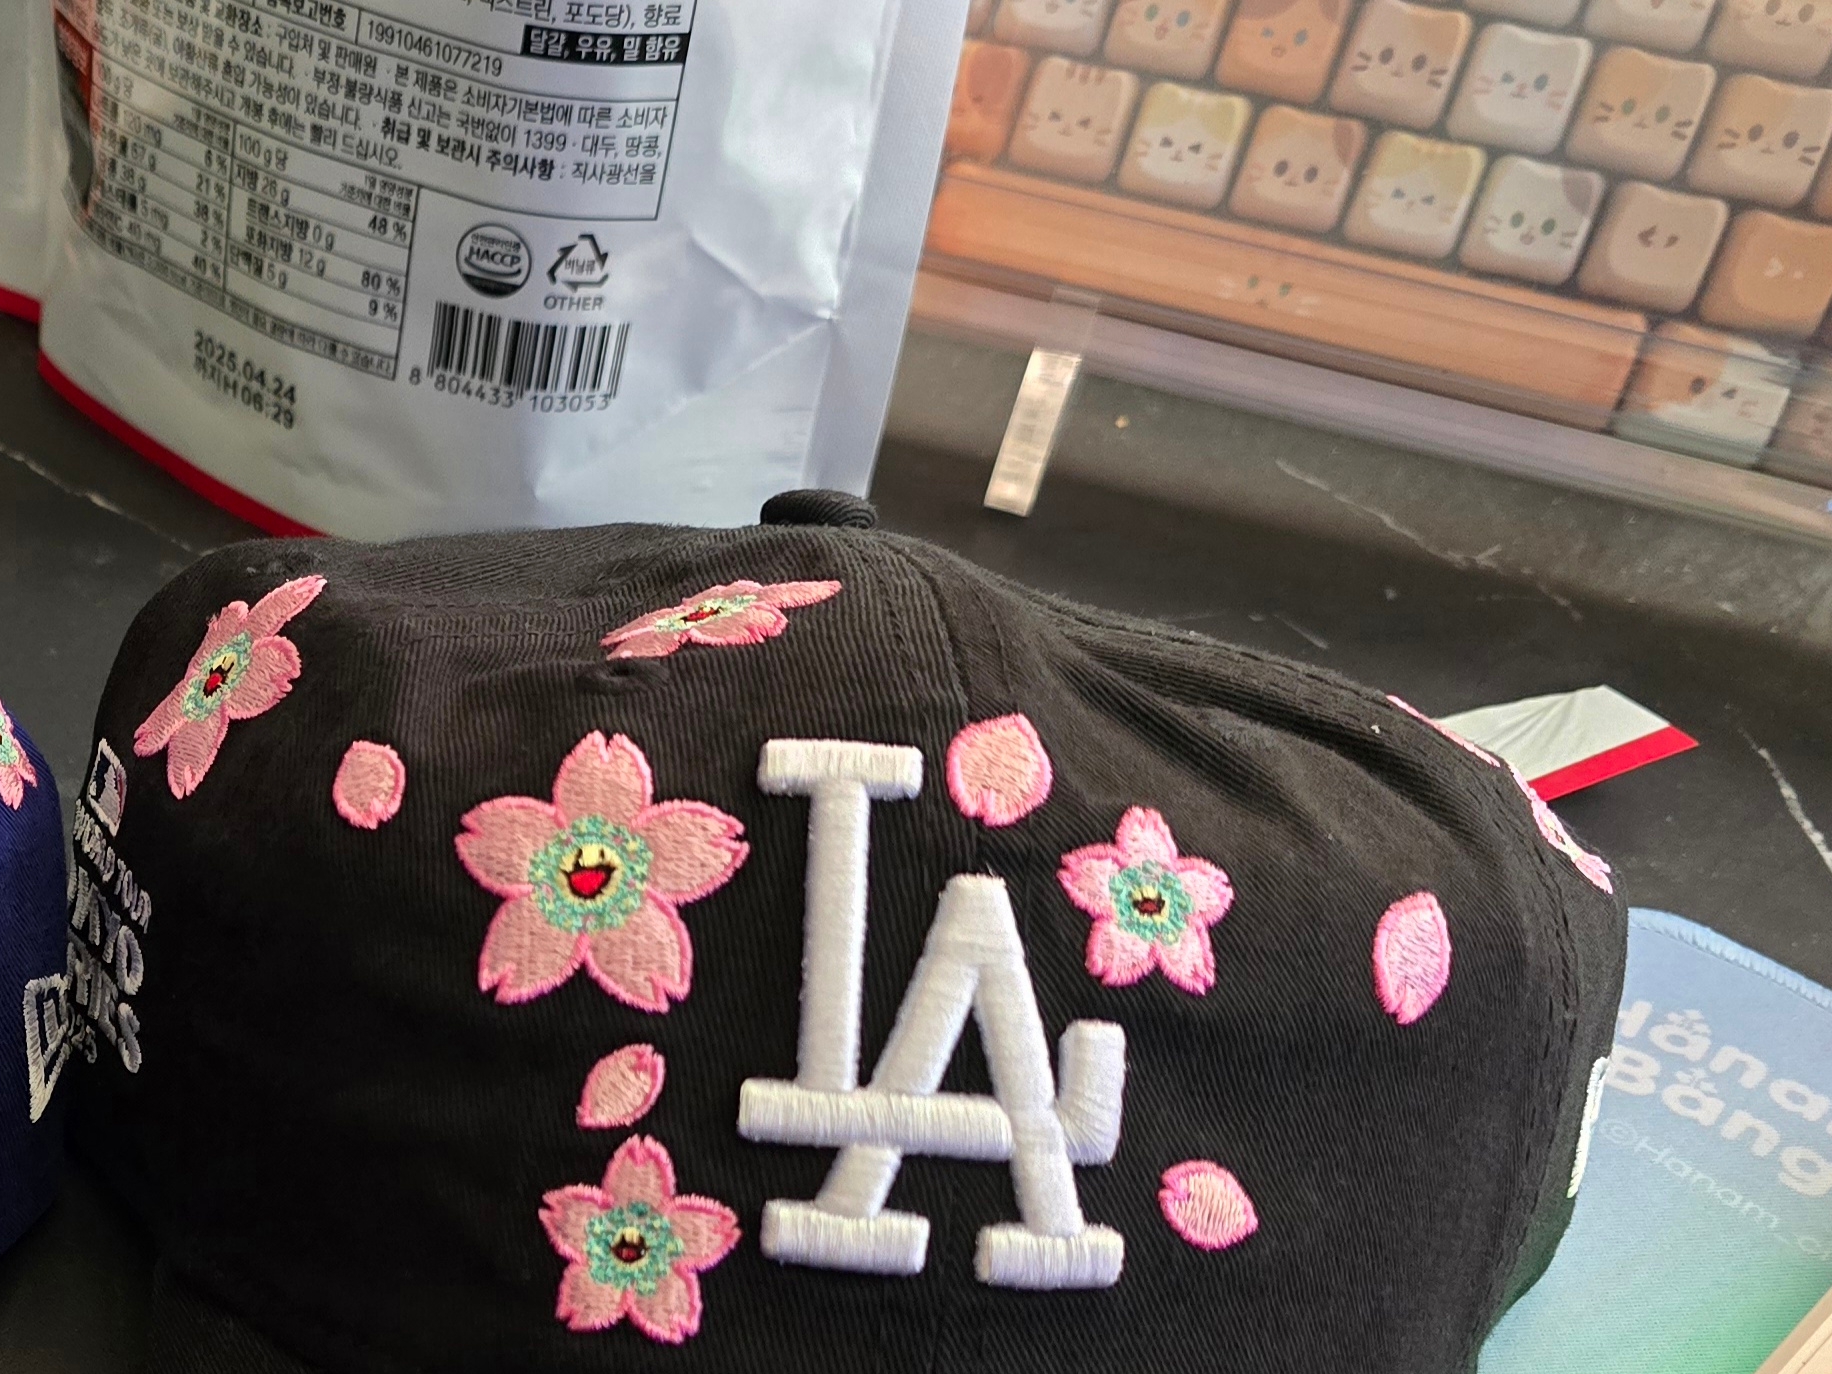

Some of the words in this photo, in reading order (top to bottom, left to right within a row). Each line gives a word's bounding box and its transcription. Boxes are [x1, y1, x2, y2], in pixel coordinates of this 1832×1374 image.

[480, 0, 557, 24] 스트린,
[644, 4, 682, 28] 향료
[368, 20, 503, 77] 19910461077219
[529, 28, 569, 59] 달걀,
[576, 35, 617, 63] 우유,
[622, 36, 639, 62] 밀
[645, 36, 681, 61] 함유
[275, 23, 314, 58] 구입처
[317, 38, 331, 64] 및
[394, 62, 410, 88] 본
[412, 69, 458, 103] 제품은
[461, 84, 573, 126] 소비자기본법에
[576, 104, 612, 129] 따른
[615, 106, 668, 130] 소비자
[407, 96, 451, 130] 신고는
[455, 109, 517, 149] 국번없이
[523, 129, 567, 152] 1399
[581, 134, 618, 159] 대두,
[625, 134, 662, 159] 땅콩,
[239, 133, 261, 159] 100
[381, 115, 412, 146] 취급
[416, 127, 432, 152] 및
[434, 132, 483, 167] 보관시
[485, 147, 555, 181] 주의사항
[571, 161, 657, 186] 직사광선을
[369, 213, 388, 236] 48
[468, 245, 522, 268] HACCP
[361, 269, 381, 291] 80
[369, 298, 379, 318] 9
[543, 295, 605, 312] OTHER
[193, 329, 297, 405] 2025.04.24
[408, 366, 421, 386] 8
[433, 373, 516, 409] 804433
[529, 393, 612, 413] 103053
[736, 737, 1128, 1290] LA
